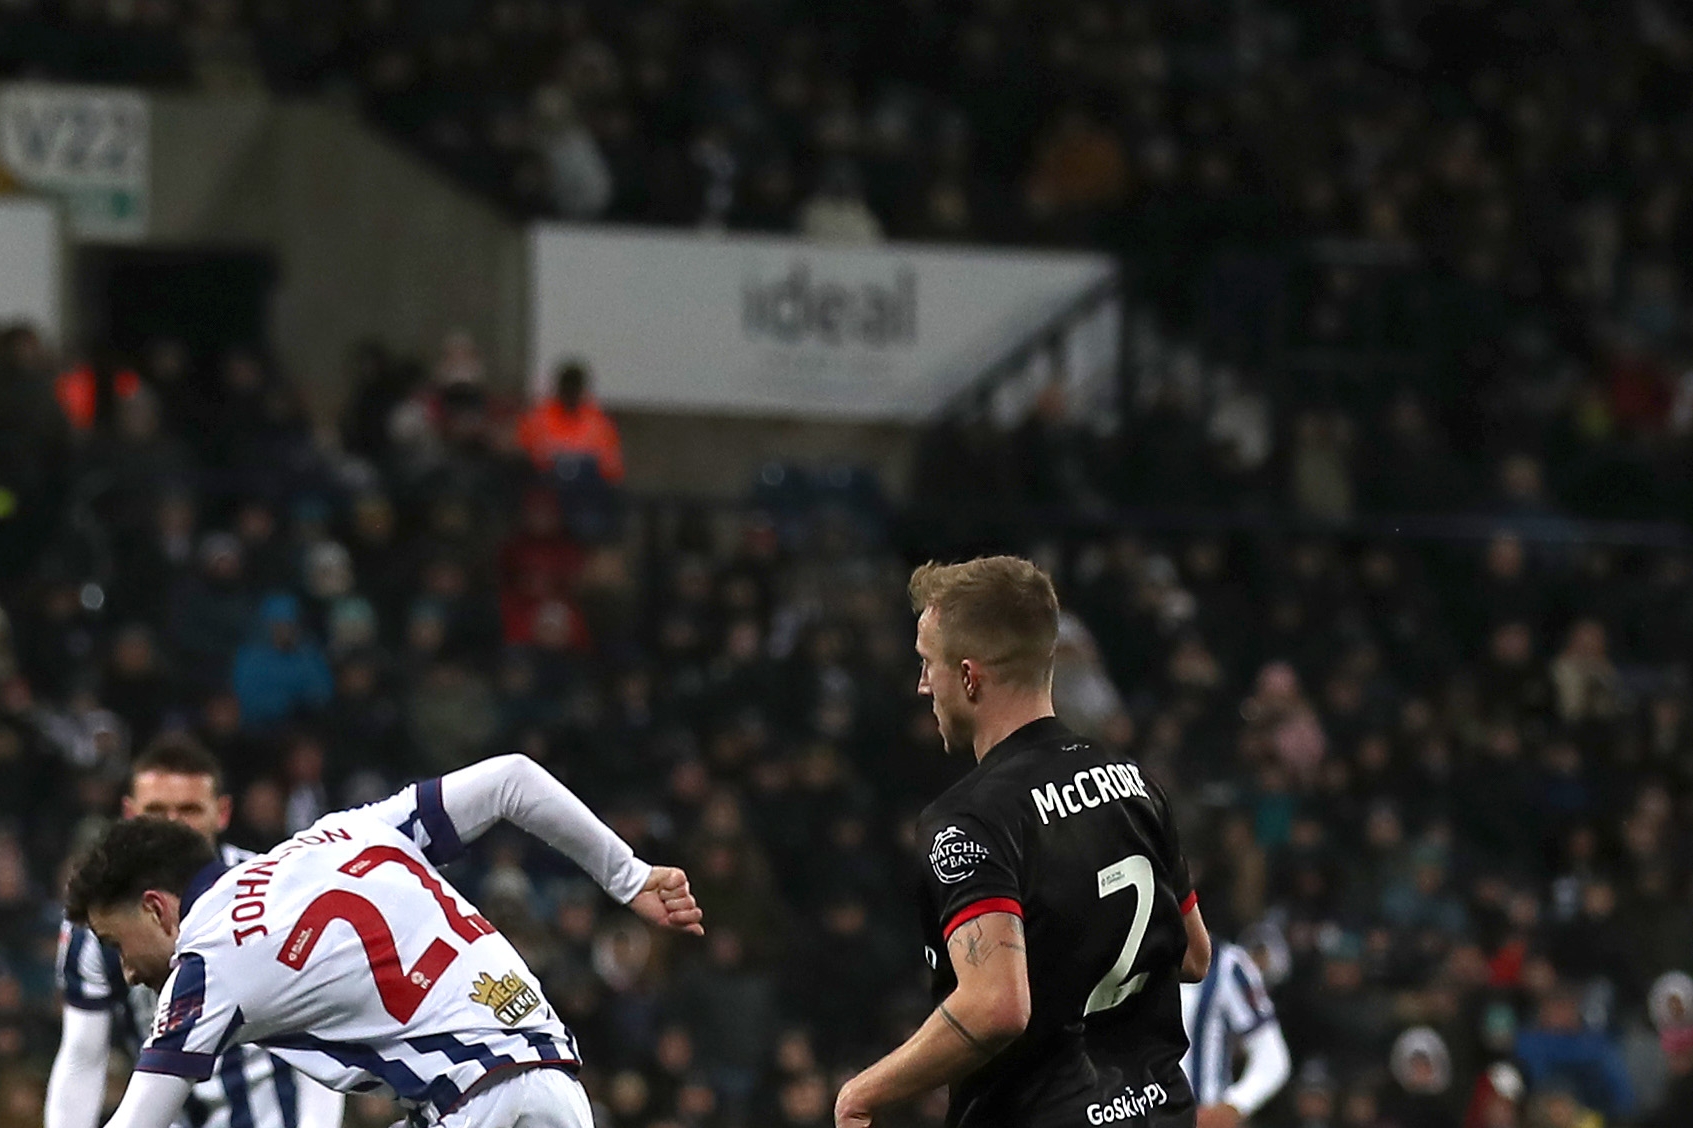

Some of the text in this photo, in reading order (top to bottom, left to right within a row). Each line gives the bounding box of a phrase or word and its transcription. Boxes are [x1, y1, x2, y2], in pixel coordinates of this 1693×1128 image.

[741, 258, 918, 346] ideal
[230, 827, 353, 947] JOHNON
[1082, 854, 1155, 1018] 2
